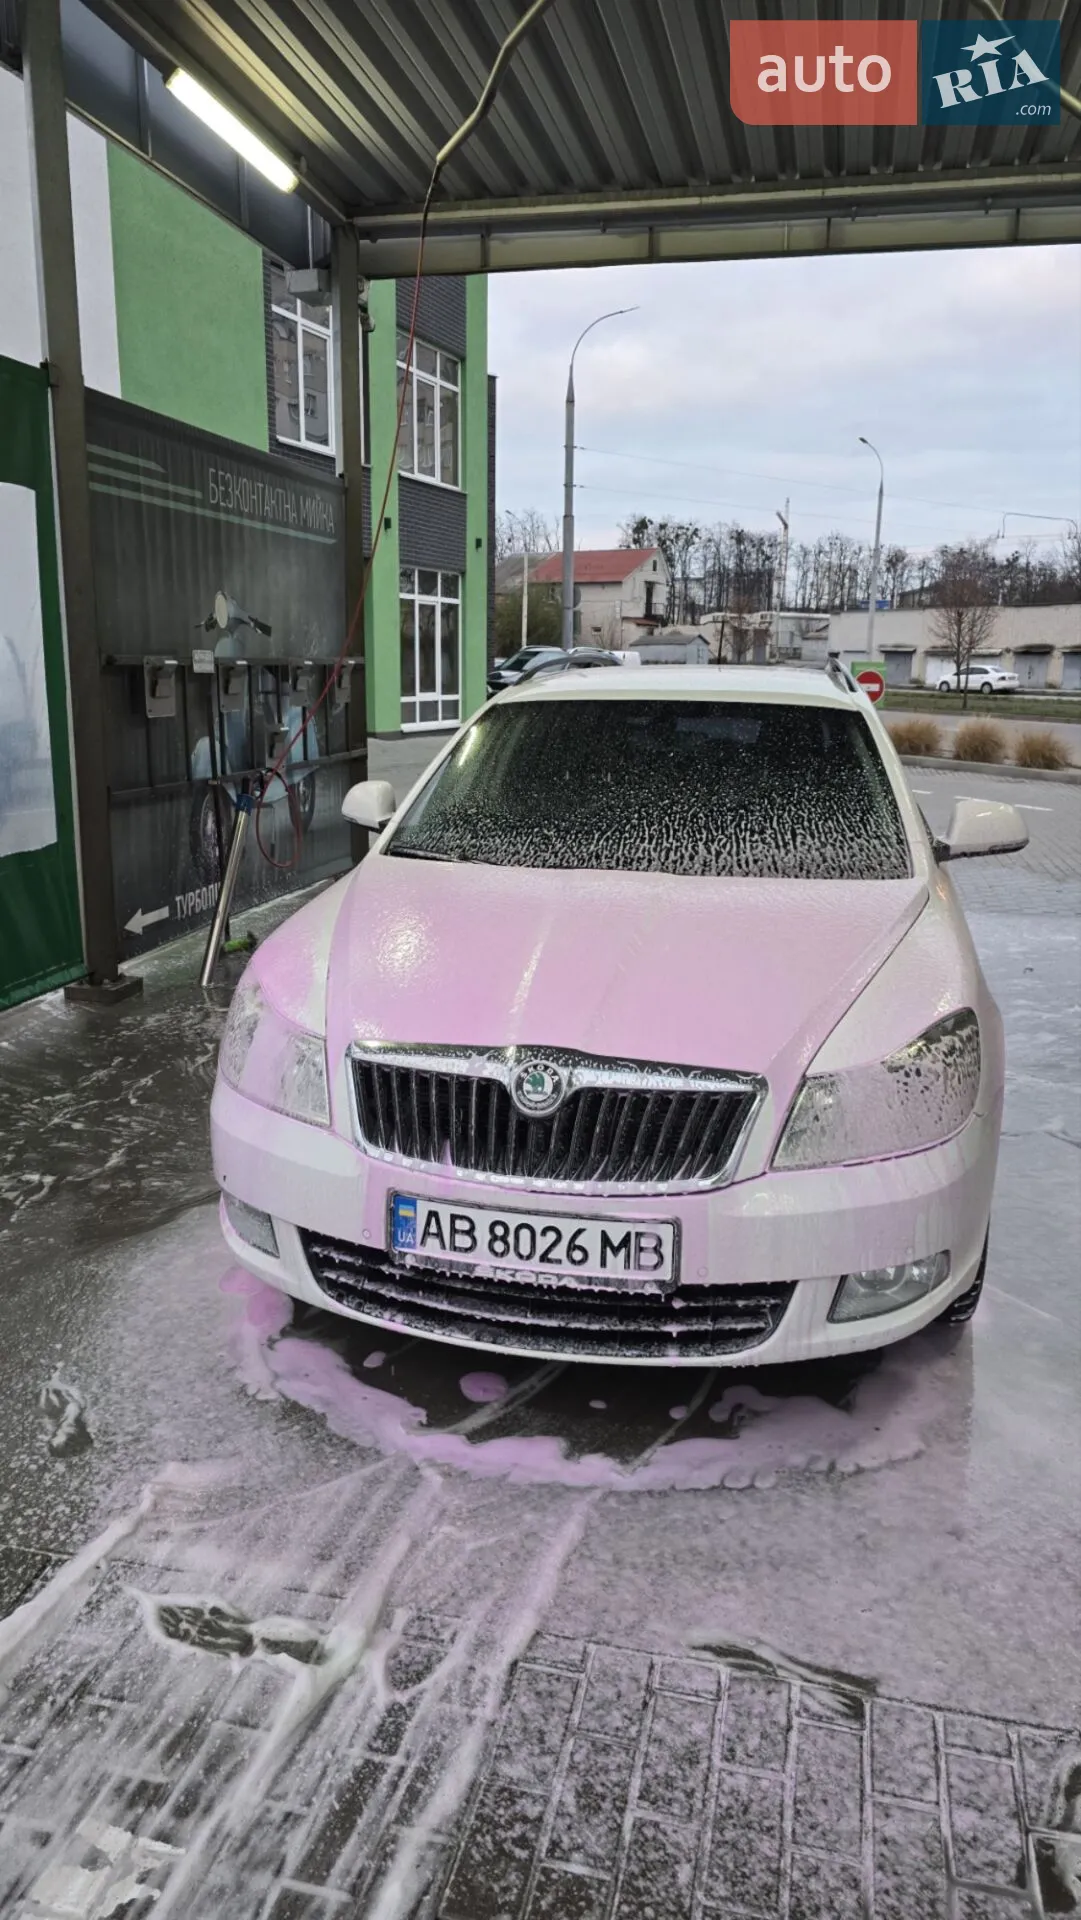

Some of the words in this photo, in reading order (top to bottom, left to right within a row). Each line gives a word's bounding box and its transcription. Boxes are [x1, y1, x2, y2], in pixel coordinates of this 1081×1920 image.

[208, 467, 298, 524] БЕЗКОНТАКТНА
[300, 494, 335, 534] МИЙКА
[398, 1229, 414, 1244] UA
[419, 1210, 477, 1253] AB
[488, 1219, 590, 1266] 8026
[600, 1229, 664, 1271] MB
